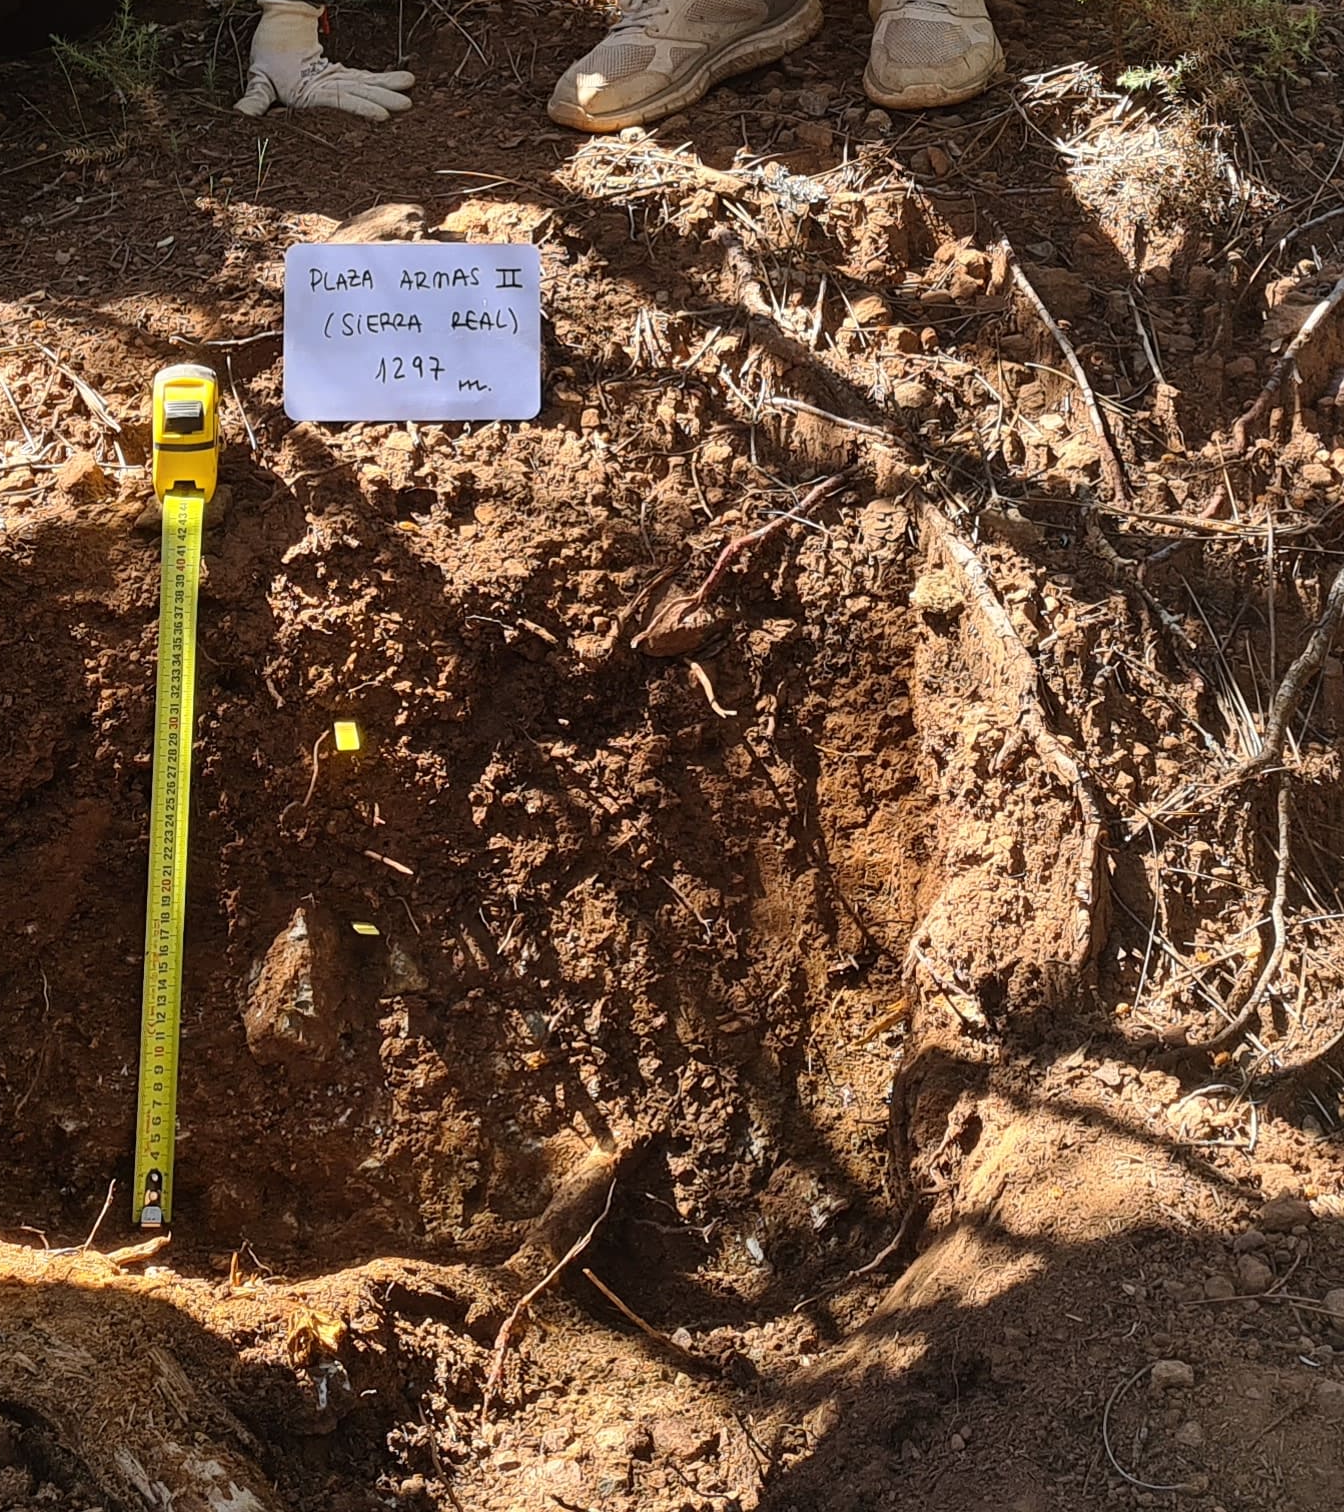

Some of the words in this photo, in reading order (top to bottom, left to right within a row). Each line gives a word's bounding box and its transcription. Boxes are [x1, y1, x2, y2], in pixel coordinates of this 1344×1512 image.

[309, 268, 373, 292] PLAZA
[400, 267, 480, 289] ARMAS
[495, 268, 523, 288] II
[451, 308, 519, 335] REAL)
[375, 356, 445, 384] 1297
[178, 527, 187, 541] 42
[177, 545, 186, 556] 41
[176, 574, 185, 588] 39
[175, 591, 184, 603] 38
[174, 606, 184, 619] 37
[174, 621, 183, 635] 36
[173, 637, 182, 651] 35
[172, 653, 181, 666] 34
[171, 669, 181, 682] 33
[171, 685, 180, 698] 32
[170, 703, 179, 714] 31
[169, 717, 178, 729] 30
[168, 733, 178, 746] 29
[168, 748, 177, 762] 28
[167, 766, 177, 779] 27
[167, 781, 176, 795] 26
[165, 797, 175, 811] 25
[165, 814, 174, 827] 24
[164, 830, 173, 843] 23
[164, 846, 173, 860] 22
[163, 865, 172, 877] 21
[162, 879, 171, 892] 20
[161, 895, 171, 907] 19
[161, 911, 170, 923] 18
[160, 929, 170, 940] 17
[159, 945, 169, 956] 16
[159, 962, 168, 973] 15
[158, 979, 167, 990] 14
[157, 995, 167, 1006] 13
[157, 1011, 166, 1023] 12
[155, 1031, 165, 1040] 11
[154, 1046, 164, 1057] 10
[154, 1065, 163, 1074] 9
[153, 1082, 163, 1092] 8
[152, 1100, 162, 1108] 7
[152, 1116, 161, 1125] 6
[150, 1133, 160, 1143] 5
[150, 1152, 160, 1160] 4
